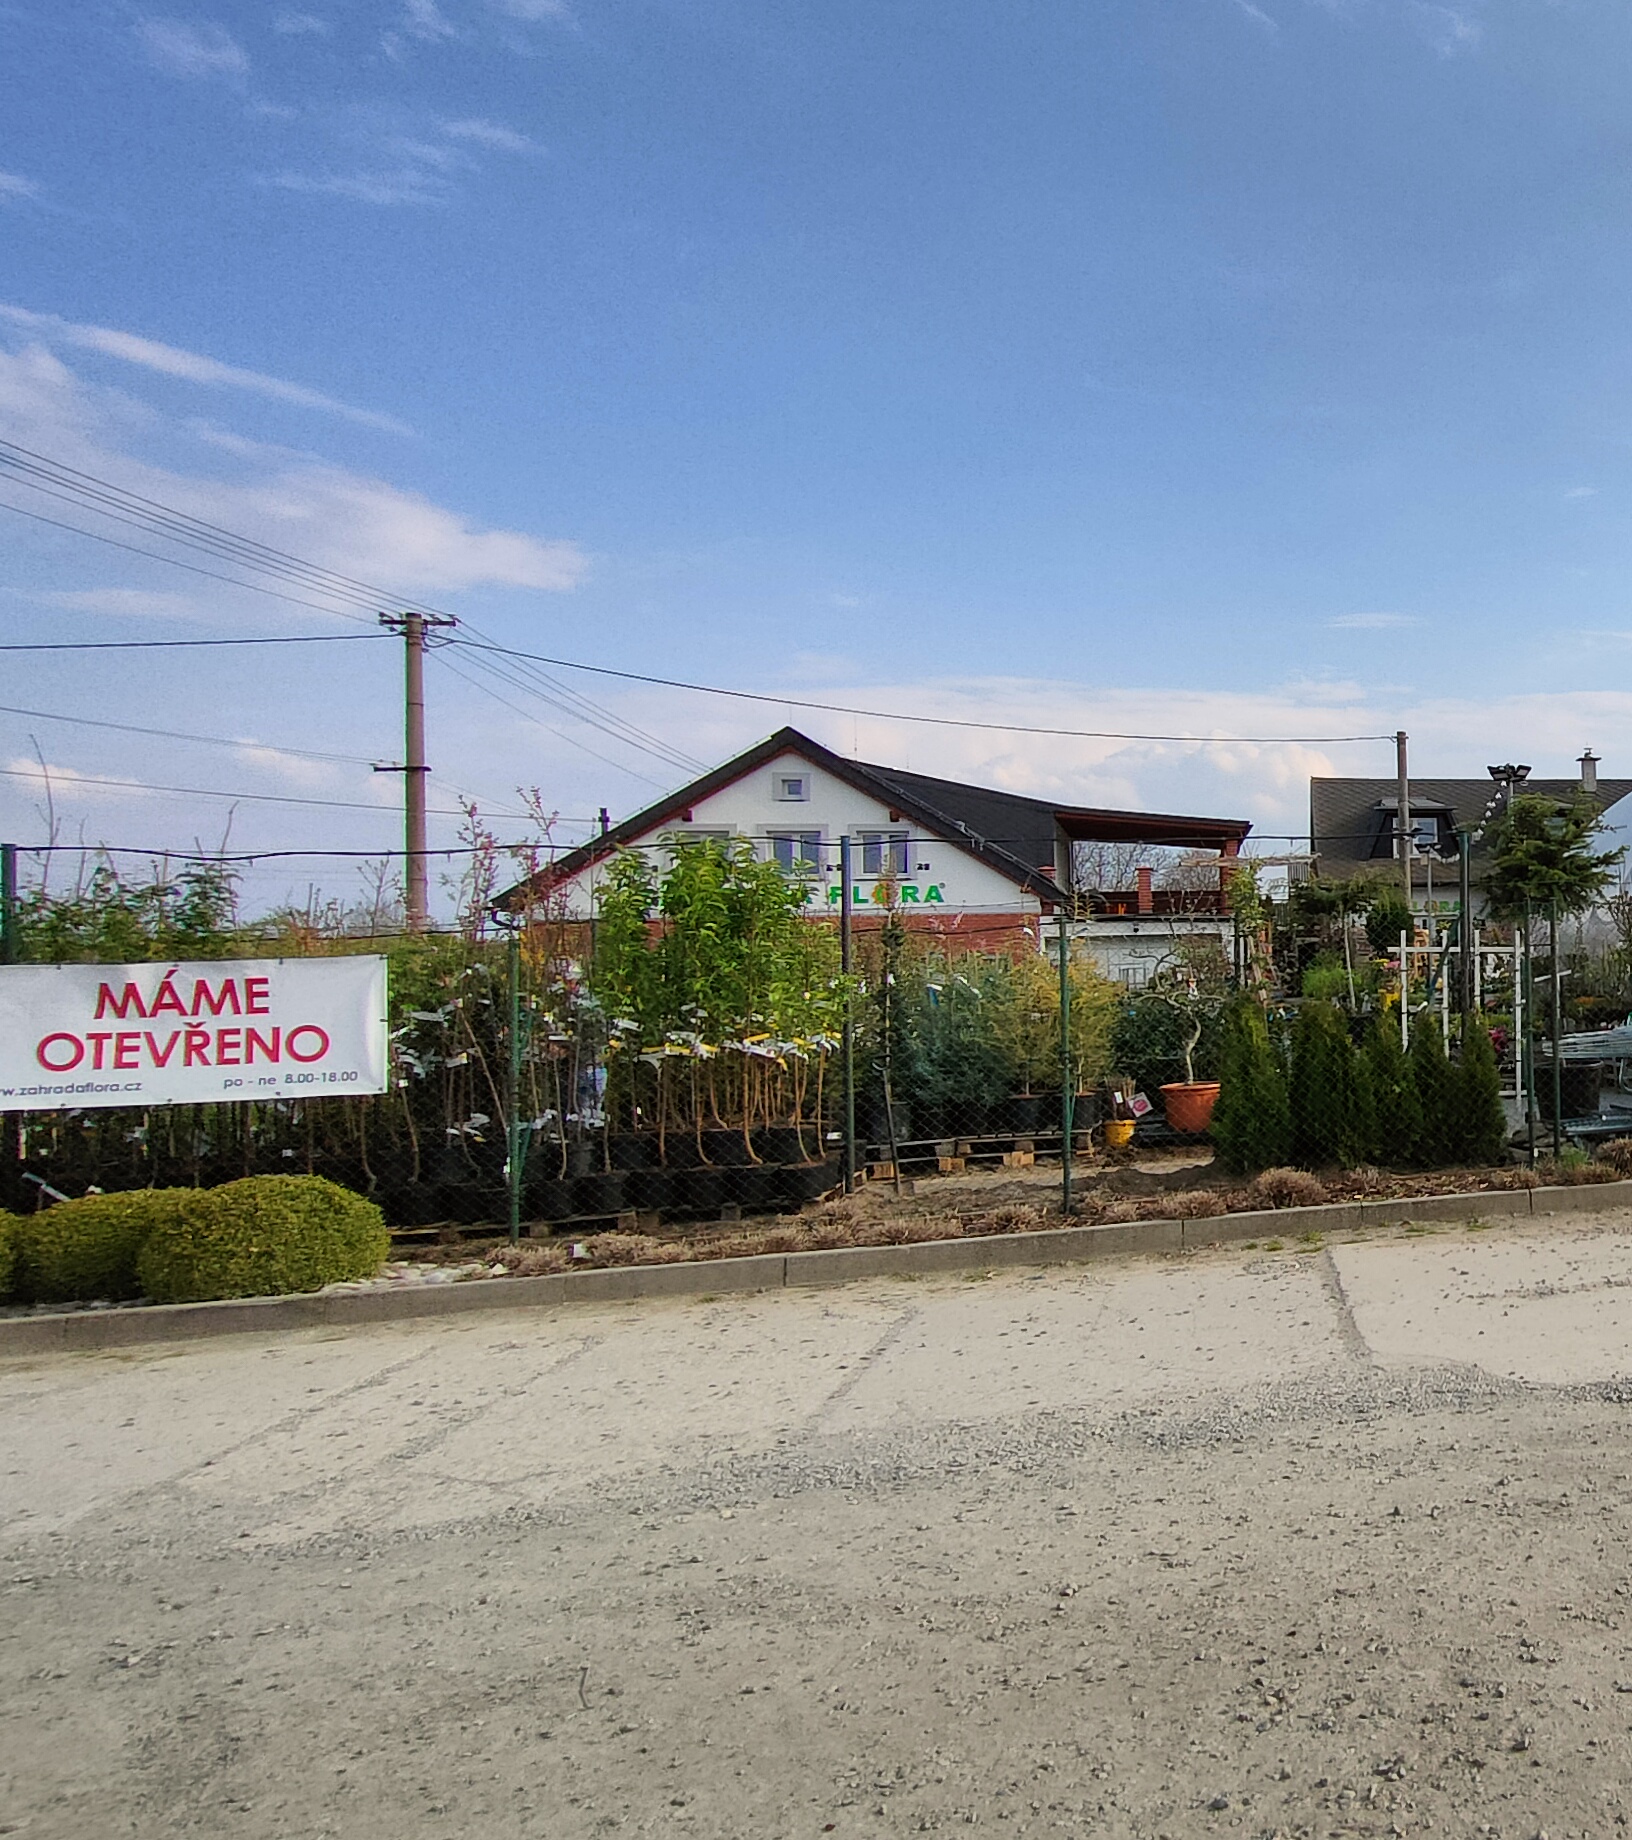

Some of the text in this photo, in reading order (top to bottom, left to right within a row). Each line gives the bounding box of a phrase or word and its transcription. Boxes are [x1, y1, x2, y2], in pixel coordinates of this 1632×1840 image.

[93, 968, 271, 1020] MÁME
[36, 1021, 330, 1072] OTEVŘENO
[223, 1078, 243, 1090] po
[258, 1076, 277, 1086] ne
[284, 1071, 358, 1085] 8.00-18.00
